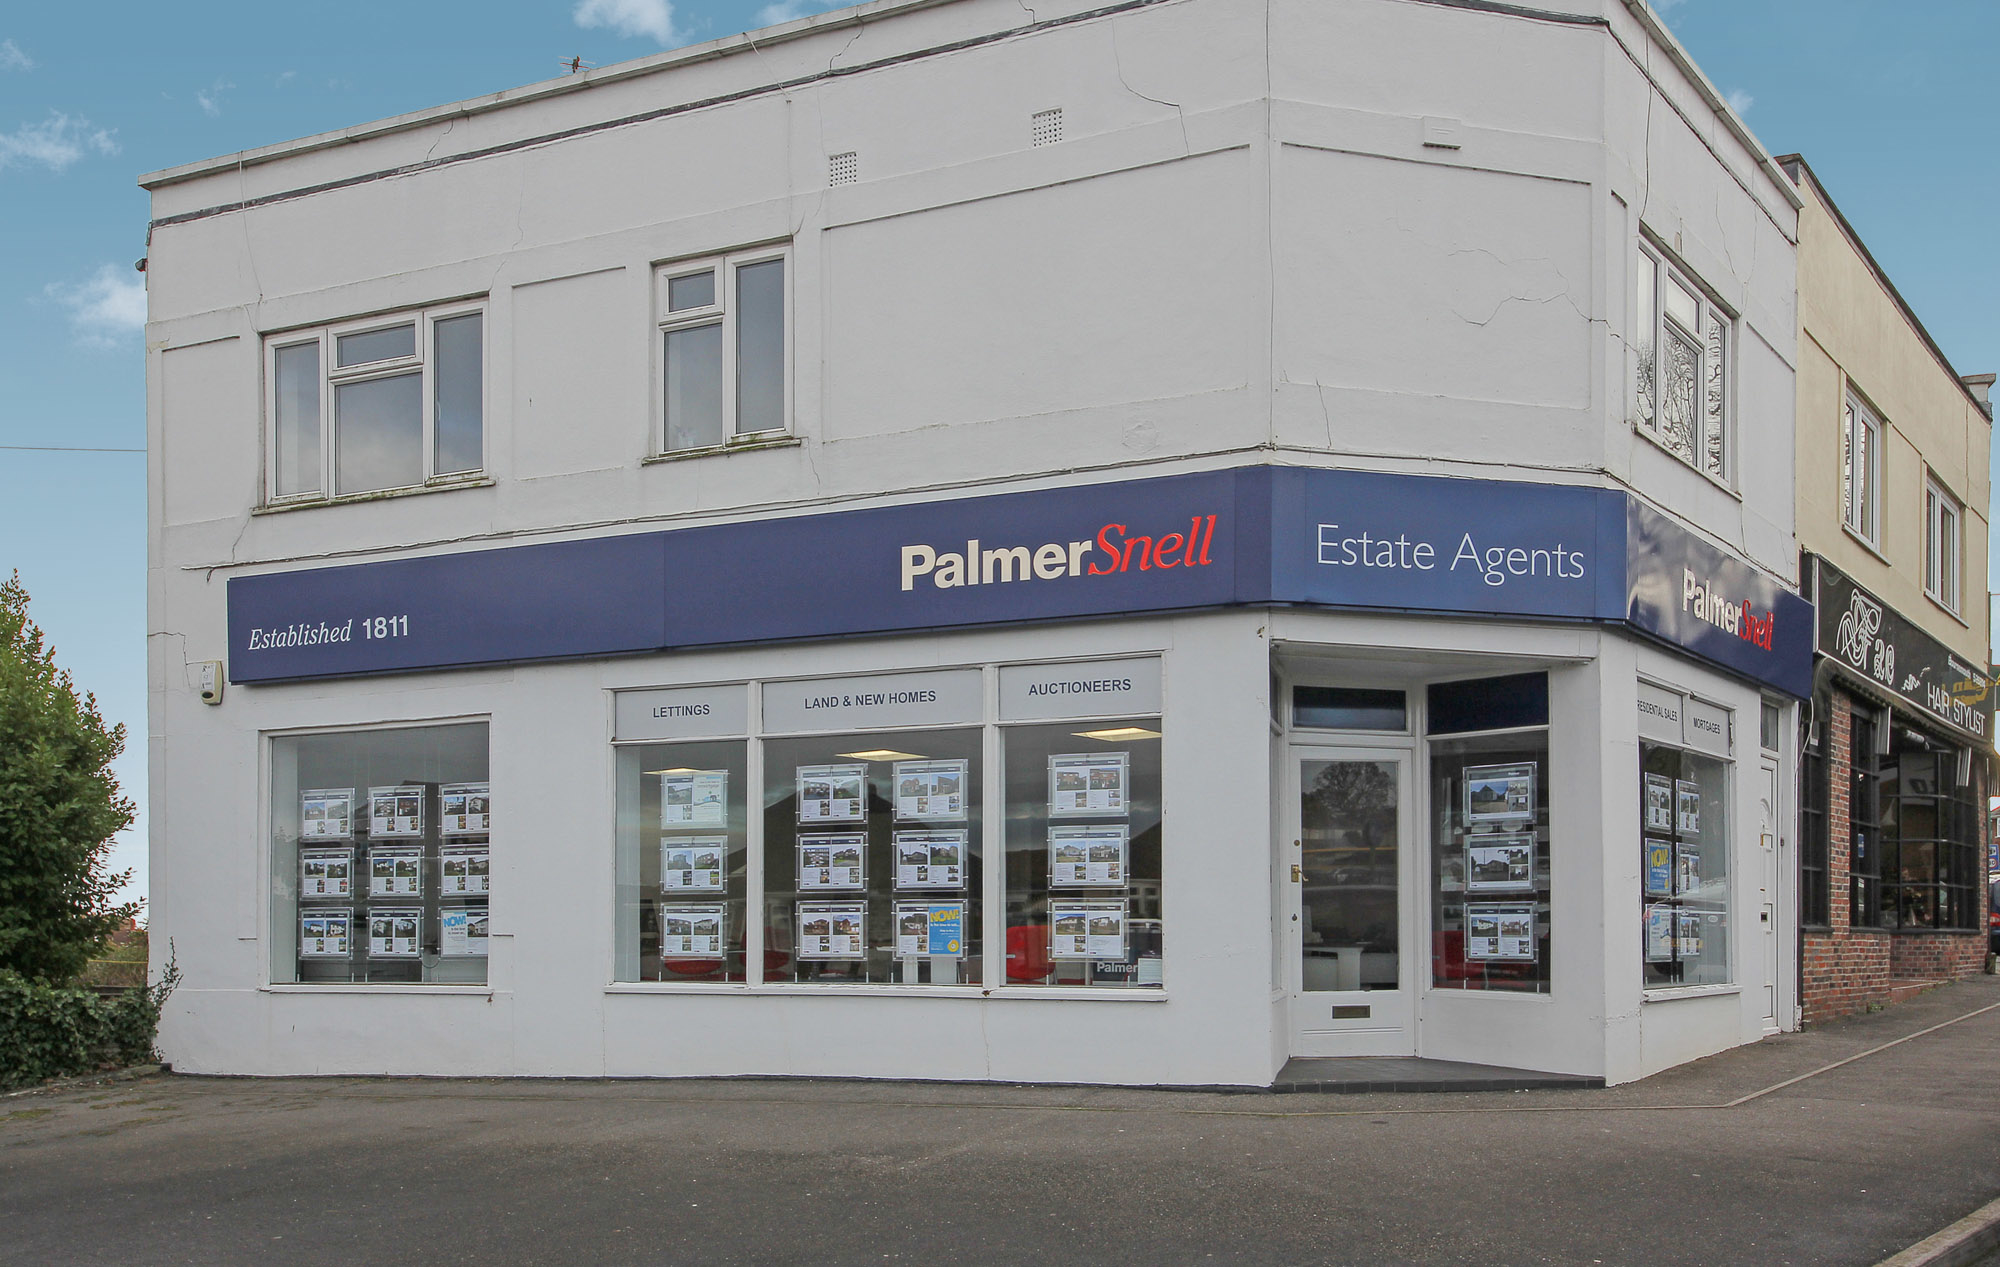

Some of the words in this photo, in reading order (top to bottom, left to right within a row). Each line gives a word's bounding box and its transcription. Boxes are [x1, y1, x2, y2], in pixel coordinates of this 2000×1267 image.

[1316, 523, 1435, 570] Estate
[1450, 532, 1585, 586] Agents
[248, 619, 352, 650] Established
[362, 614, 409, 640] 1811
[1028, 679, 1131, 696] AUCTIONEERS
[804, 697, 839, 709] LAND
[843, 696, 852, 707] &
[855, 694, 885, 706] NEW
[889, 690, 936, 704] HOMES
[653, 704, 710, 718] LETTINGS
[1637, 699, 1663, 718] RESIDENTIAL
[1664, 707, 1678, 722] SALES
[1927, 682, 1949, 717] HAIR
[1953, 698, 1985, 736] STYLIST
[1693, 717, 1720, 734] MORTGAGES
[443, 915, 466, 927] NOW!
[929, 909, 960, 922] NOW!
[1096, 961, 1138, 973] Palmer
